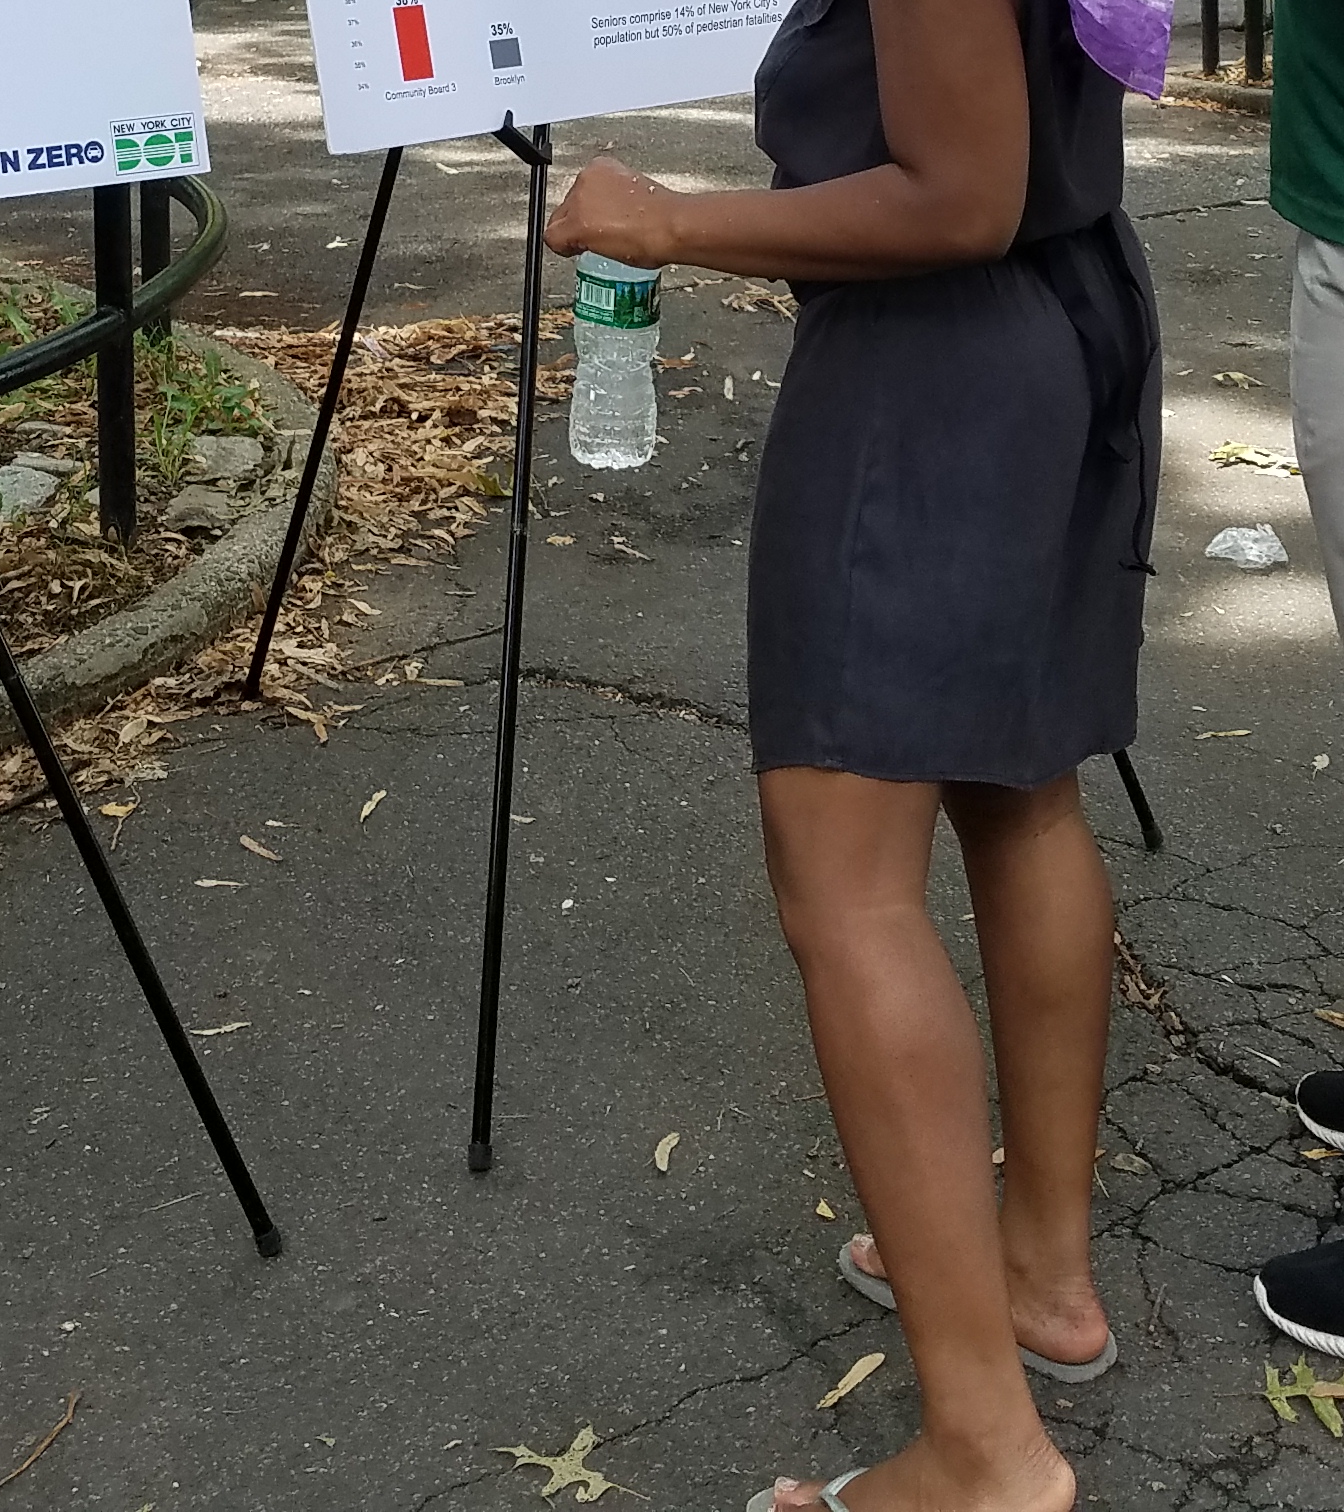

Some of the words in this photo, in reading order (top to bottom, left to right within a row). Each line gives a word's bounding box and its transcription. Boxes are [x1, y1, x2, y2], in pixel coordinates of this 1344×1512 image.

[490, 22, 514, 36] 35%
[494, 74, 525, 85] Brooklyn
[385, 88, 426, 100] Community
[428, 84, 449, 94] Board
[451, 83, 456, 91] 3
[113, 122, 136, 134] NEW
[141, 119, 168, 130] YORK
[170, 117, 192, 128] CITY
[26, 141, 104, 170] ZERO
[115, 131, 194, 172] DOT
